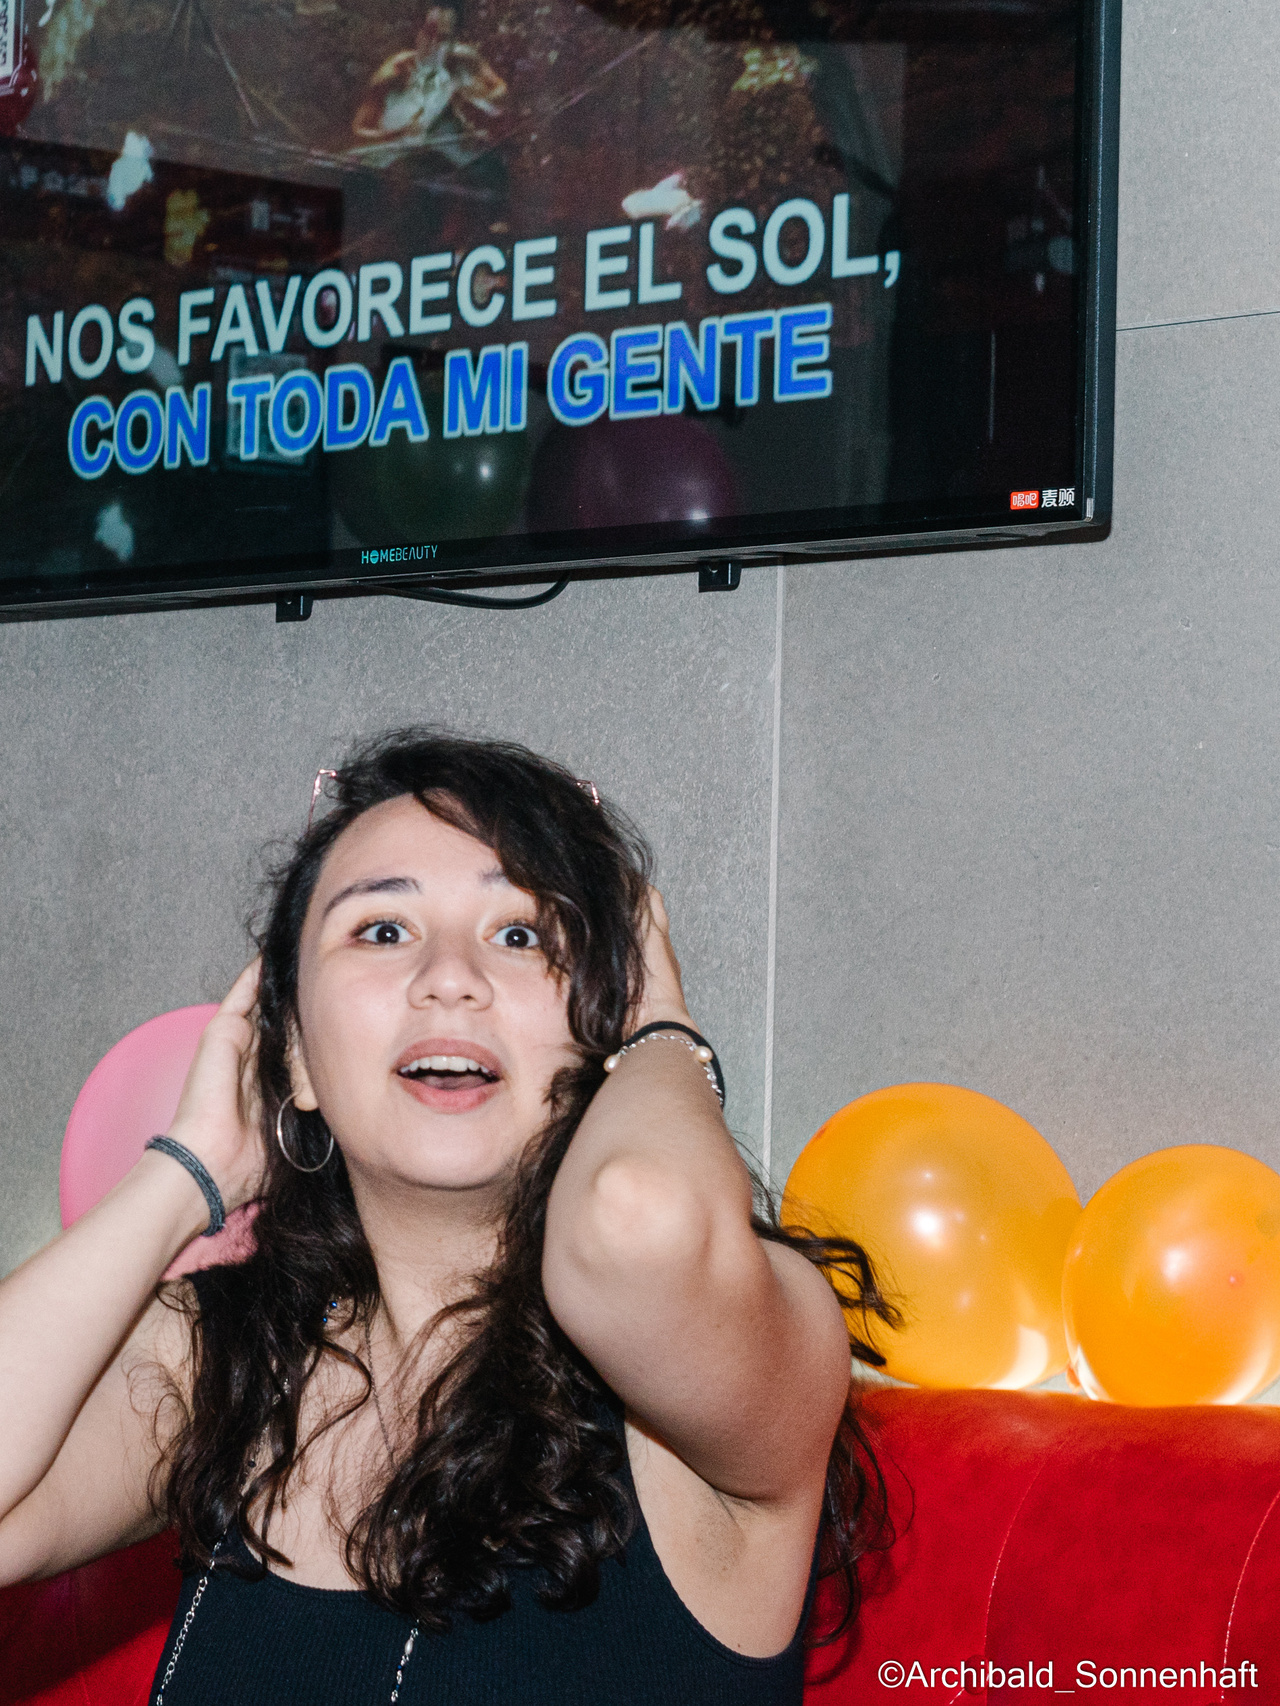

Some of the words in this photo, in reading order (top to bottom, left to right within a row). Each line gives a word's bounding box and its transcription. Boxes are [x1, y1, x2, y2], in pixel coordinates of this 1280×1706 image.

[25, 297, 156, 387] NOS
[177, 235, 558, 366] FAVORECE
[584, 222, 682, 312] EL
[706, 193, 900, 295] SOL,
[67, 382, 212, 480] CON
[226, 356, 430, 462] TODA
[442, 341, 529, 440] MI
[547, 302, 833, 427] GENTE
[1011, 492, 1038, 508] 唱吧
[361, 544, 439, 565] HOMEBEAUTY
